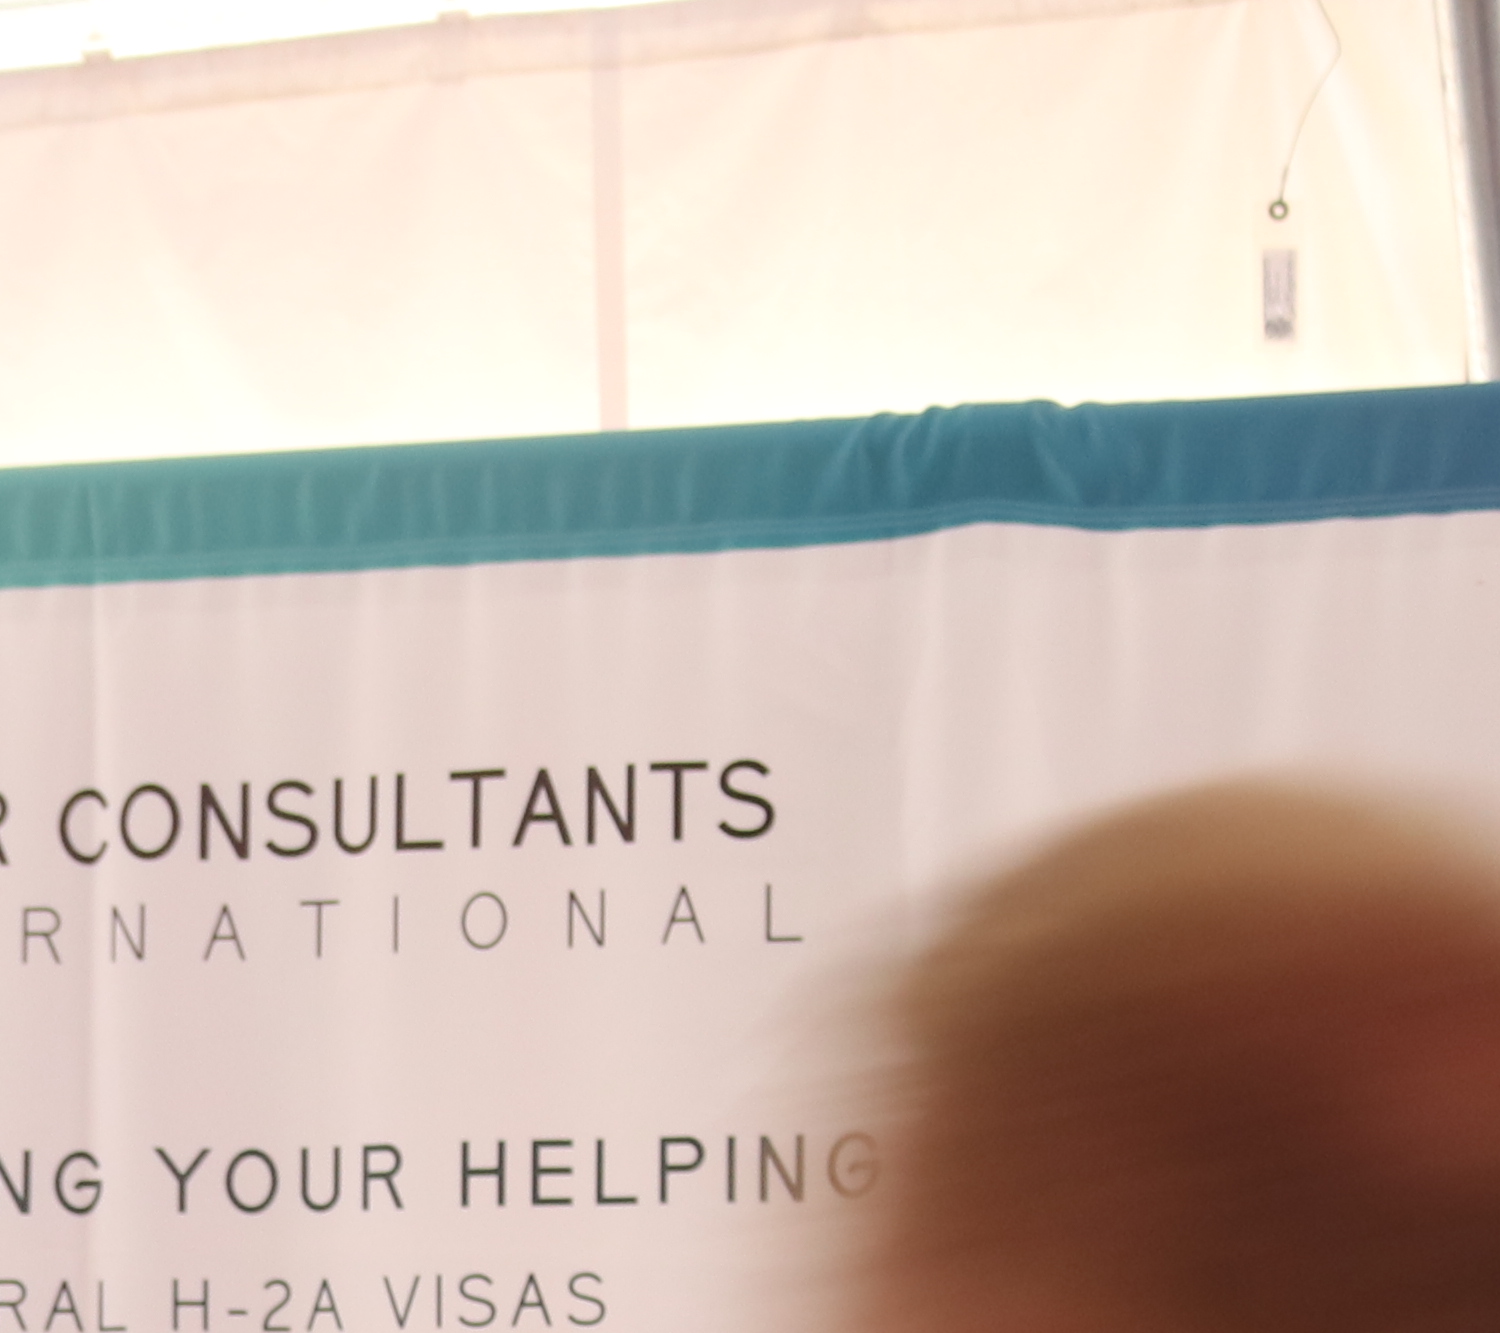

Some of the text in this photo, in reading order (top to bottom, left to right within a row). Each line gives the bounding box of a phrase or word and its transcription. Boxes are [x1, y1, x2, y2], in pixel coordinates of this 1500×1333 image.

[57, 758, 777, 868] CONSULTANTS
[154, 1143, 405, 1216] YOUR
[460, 1131, 880, 1209] HELPING
[171, 1277, 344, 1333] H-2A
[382, 1271, 607, 1330] VISAS
